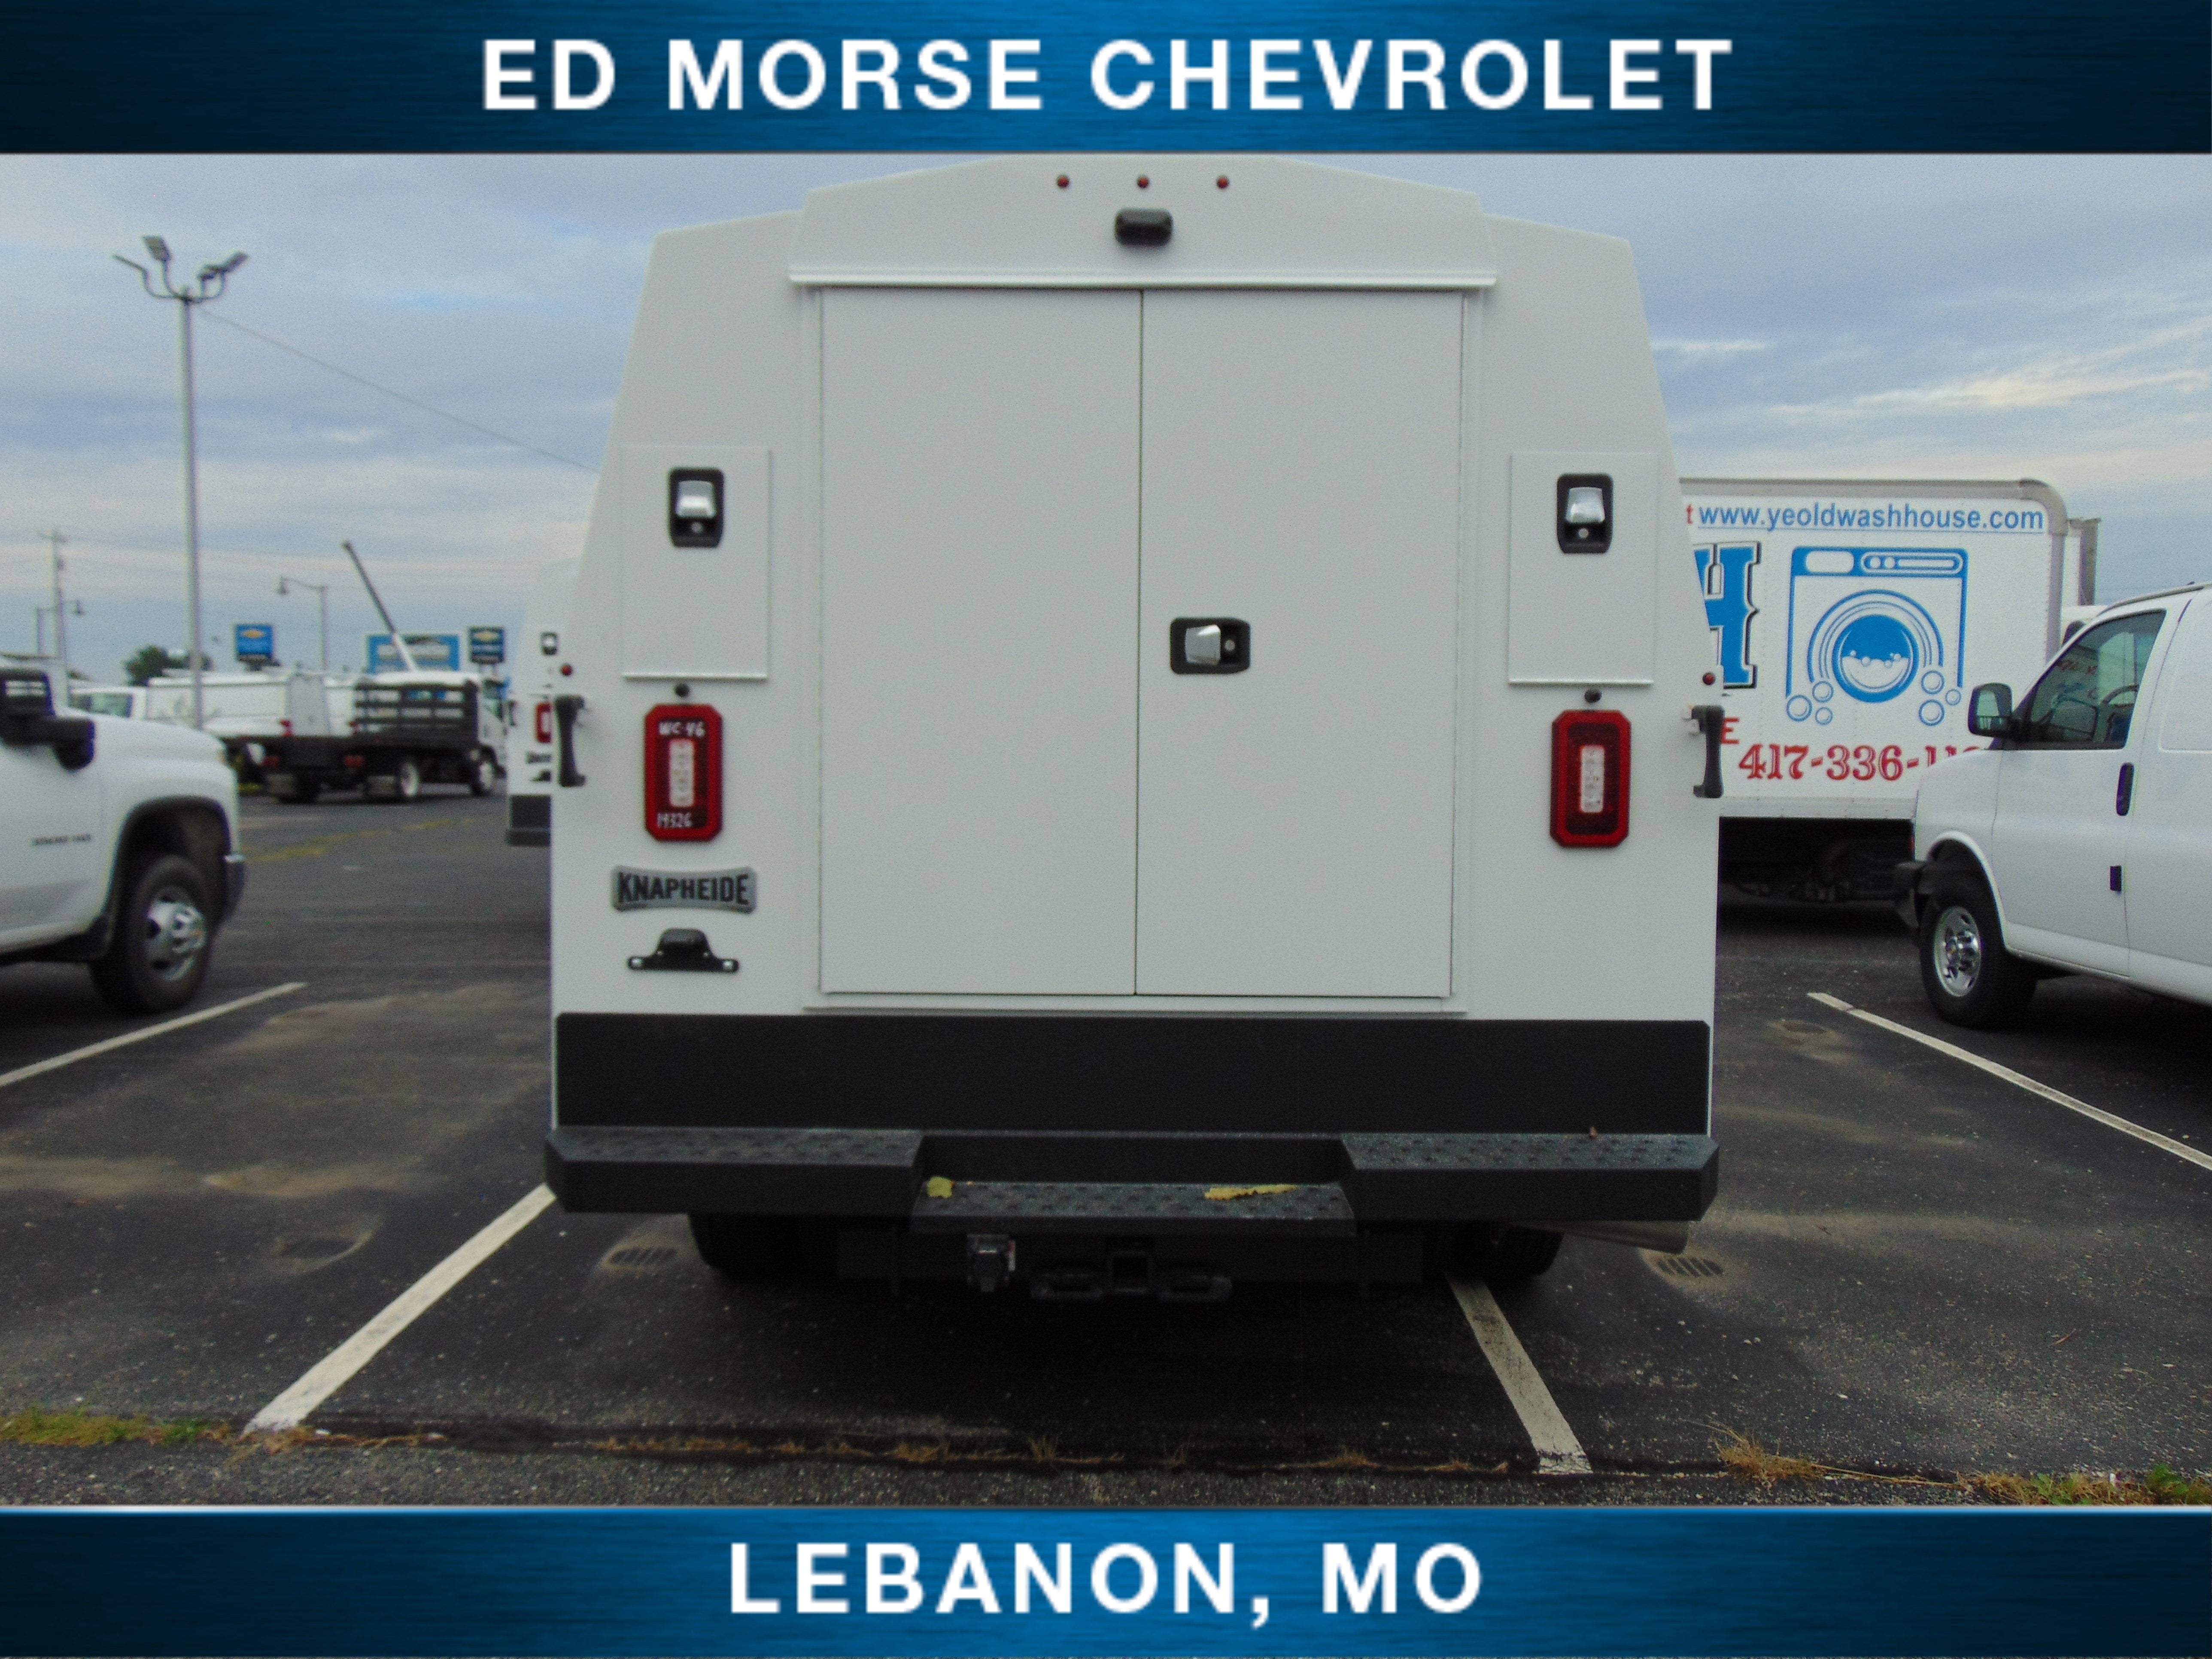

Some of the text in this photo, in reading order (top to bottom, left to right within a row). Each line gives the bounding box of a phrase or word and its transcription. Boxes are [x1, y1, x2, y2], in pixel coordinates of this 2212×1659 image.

[1698, 502, 2044, 532] www.yeoldwashhouse.com
[1738, 743, 1980, 781] 417-336-1
[618, 872, 750, 905] KNAPHEIDE
